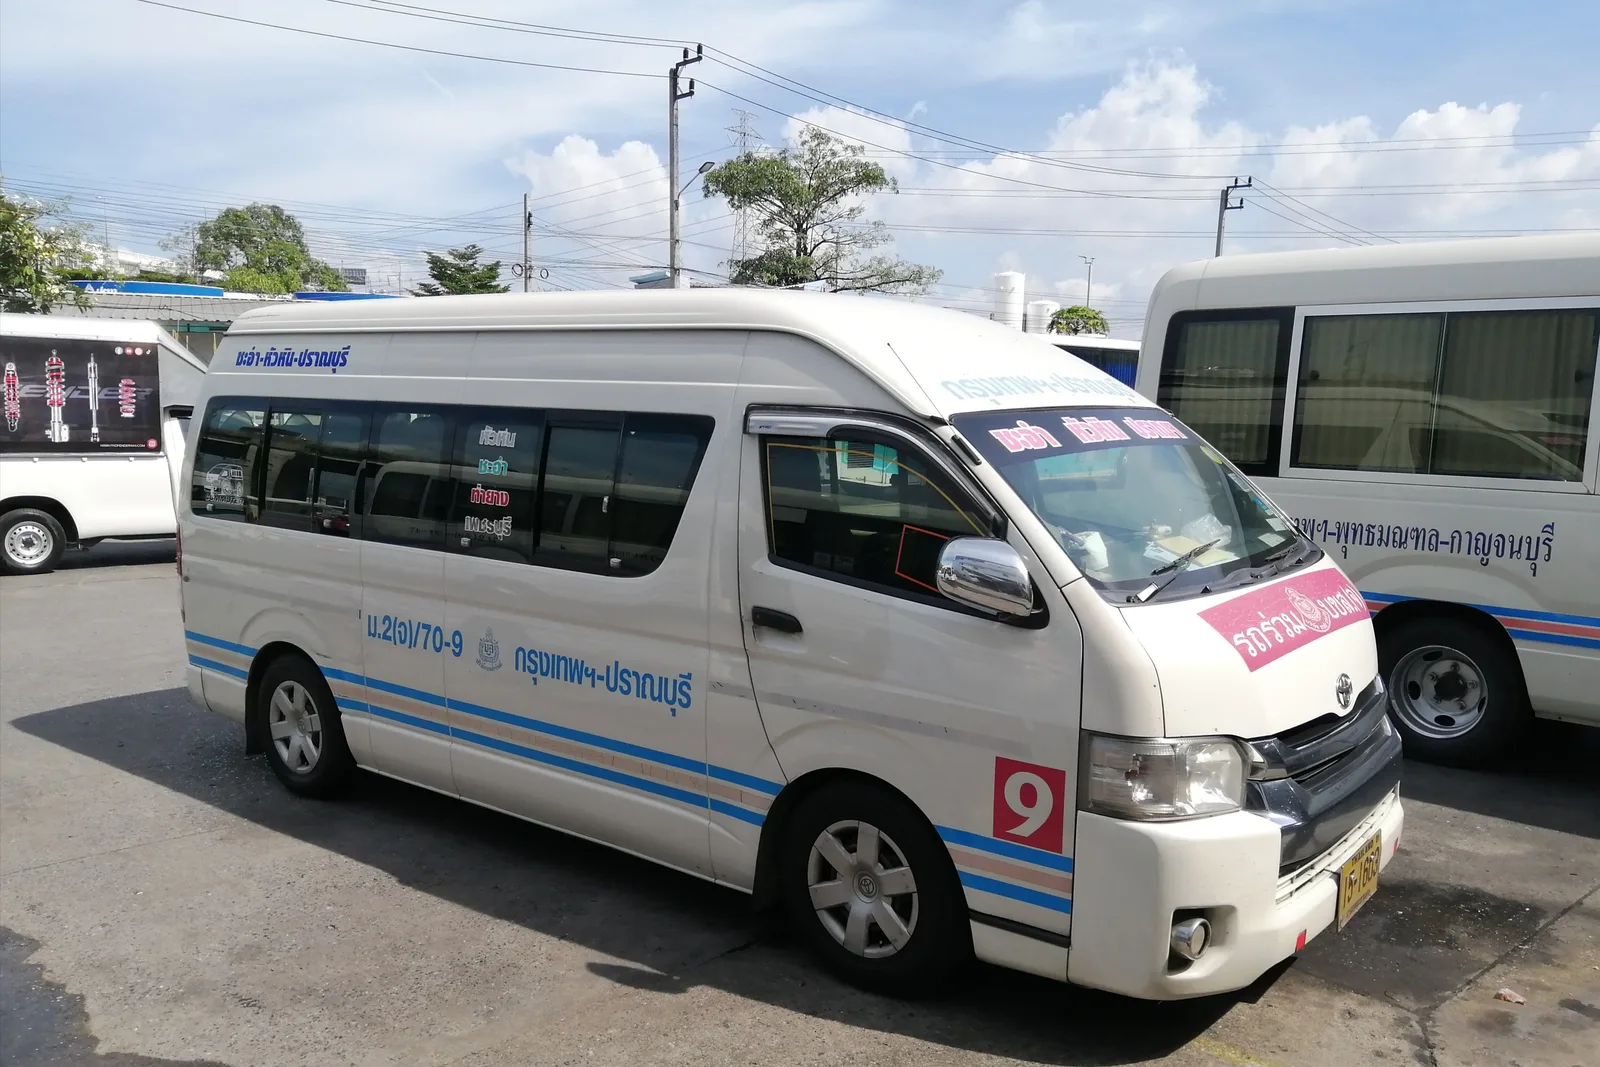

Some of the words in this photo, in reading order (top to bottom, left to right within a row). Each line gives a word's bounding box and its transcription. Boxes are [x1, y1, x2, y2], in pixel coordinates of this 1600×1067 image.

[471, 484, 510, 507] ท่ายาง
[464, 516, 512, 541] เพชรบุรี
[367, 614, 464, 658] ม.2(จ)/70-9
[1232, 610, 1308, 658] รถร่วม
[514, 646, 693, 718] กรุงเทพฯ-ปราณบุรี
[1003, 771, 1054, 838] 9
